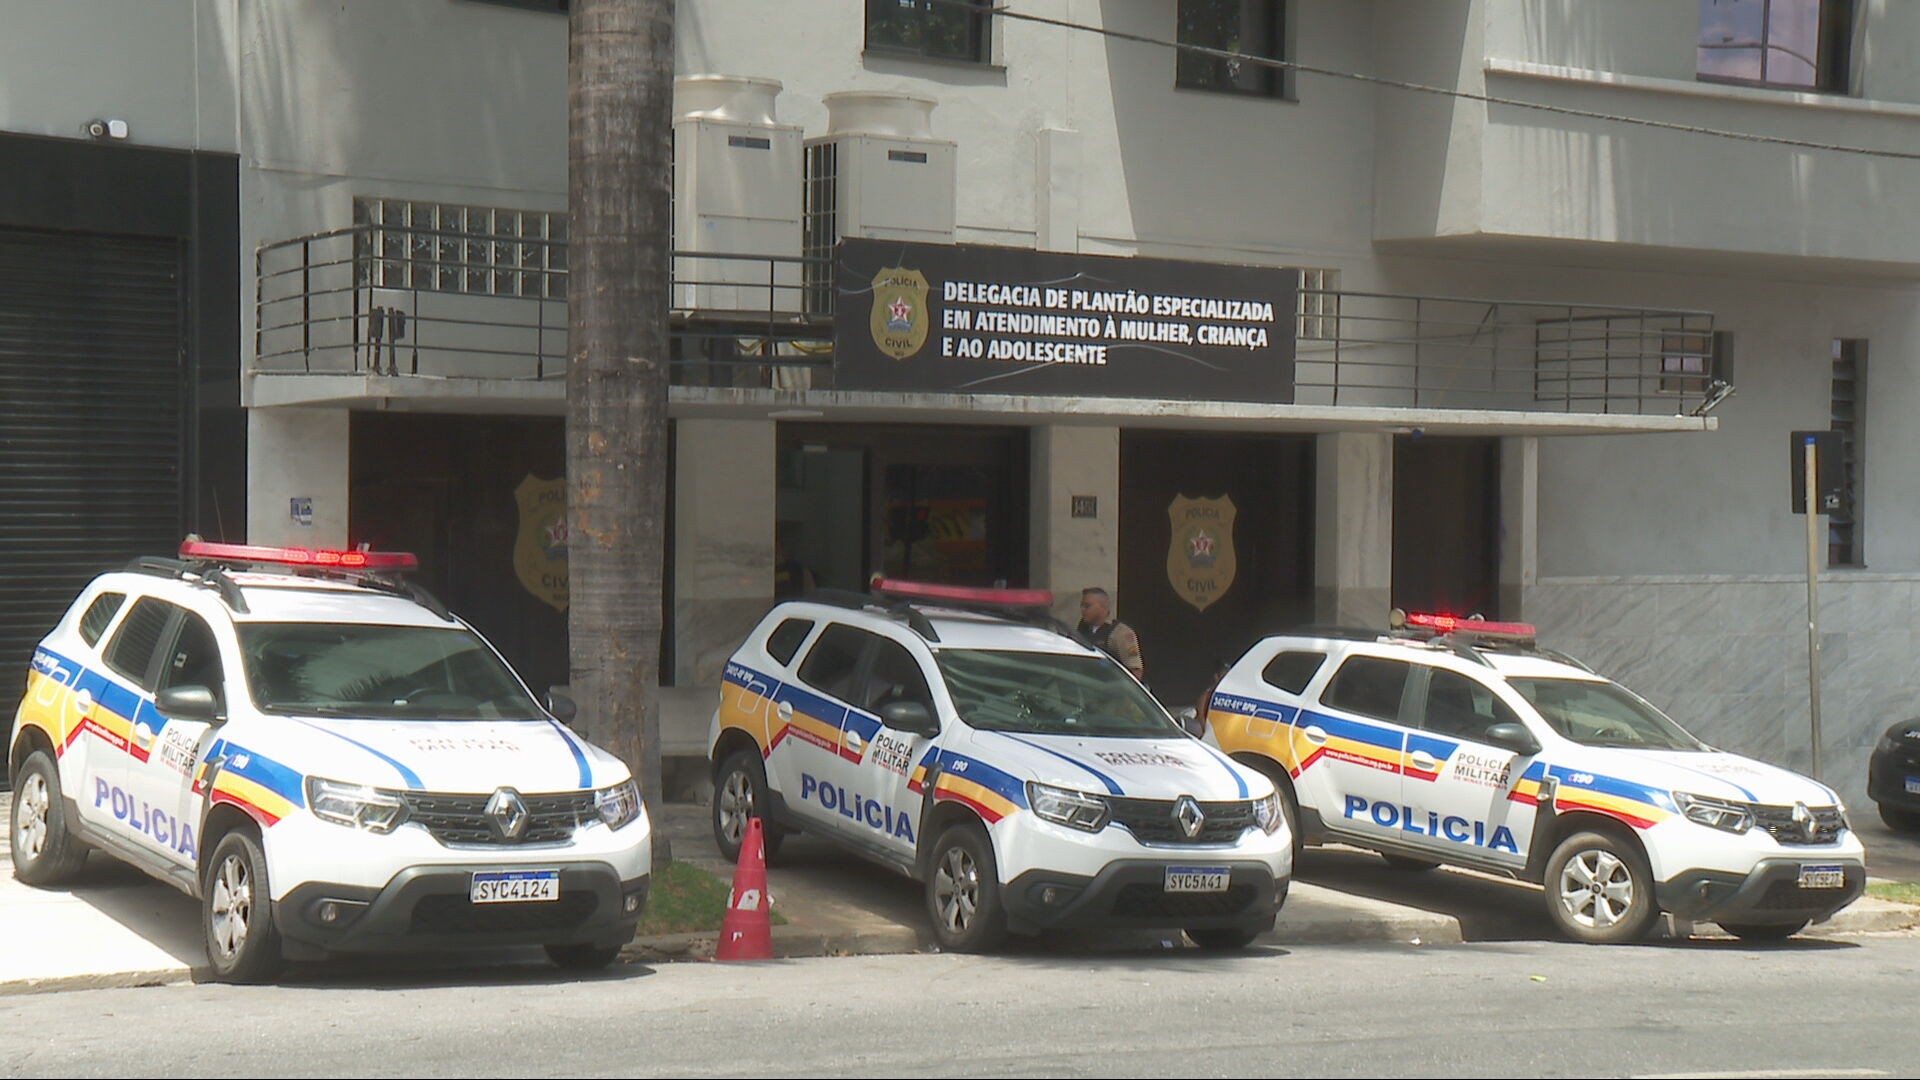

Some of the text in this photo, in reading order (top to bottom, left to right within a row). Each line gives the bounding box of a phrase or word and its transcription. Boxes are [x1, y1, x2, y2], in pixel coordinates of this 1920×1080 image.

[944, 281, 1274, 322] DELEGACIA DE PLANTÃO ESPECIALIZADA
[943, 309, 1268, 350] EM ATENDIMENTO À MULHER, CRIANÇA
[885, 338, 912, 348] CIVIL
[942, 337, 1107, 365] E AO ADOLESCENTE
[1187, 578, 1216, 591] CIVIL
[161, 743, 195, 772] MILITAR
[872, 750, 909, 774] MILITAR
[952, 760, 969, 772] 190
[1454, 765, 1509, 785] MILITAR
[1170, 875, 1222, 889] SYC5A41
